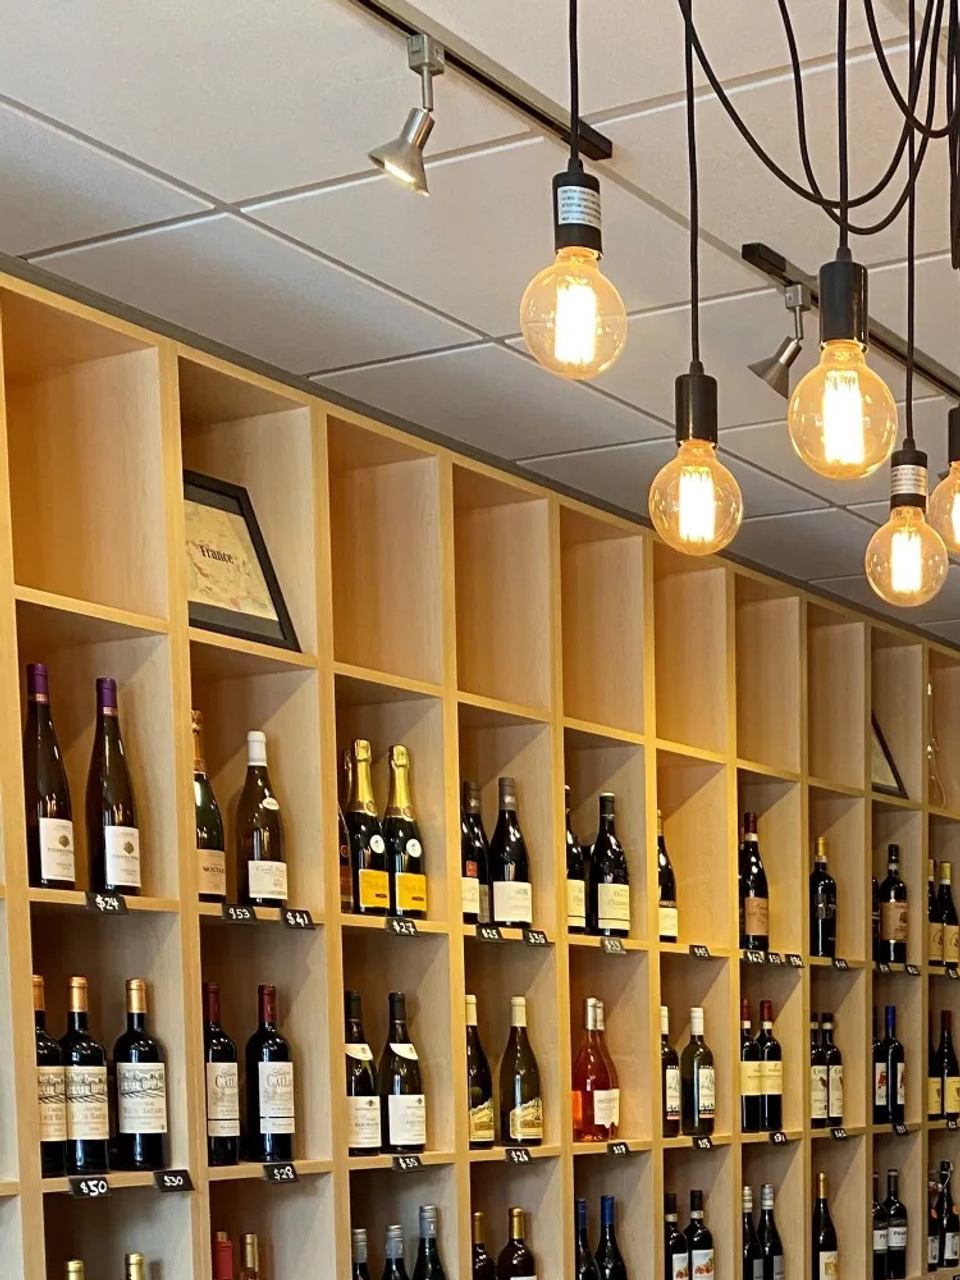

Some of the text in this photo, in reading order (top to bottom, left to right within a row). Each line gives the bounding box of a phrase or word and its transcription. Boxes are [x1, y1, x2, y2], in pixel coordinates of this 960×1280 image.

[199, 543, 234, 565] France
[95, 893, 119, 912] $24
[392, 920, 416, 936] $27
[399, 1157, 418, 1170] $35
[163, 1175, 183, 1187] $30
[274, 1166, 295, 1181] $28
[80, 1179, 107, 1197] $50
